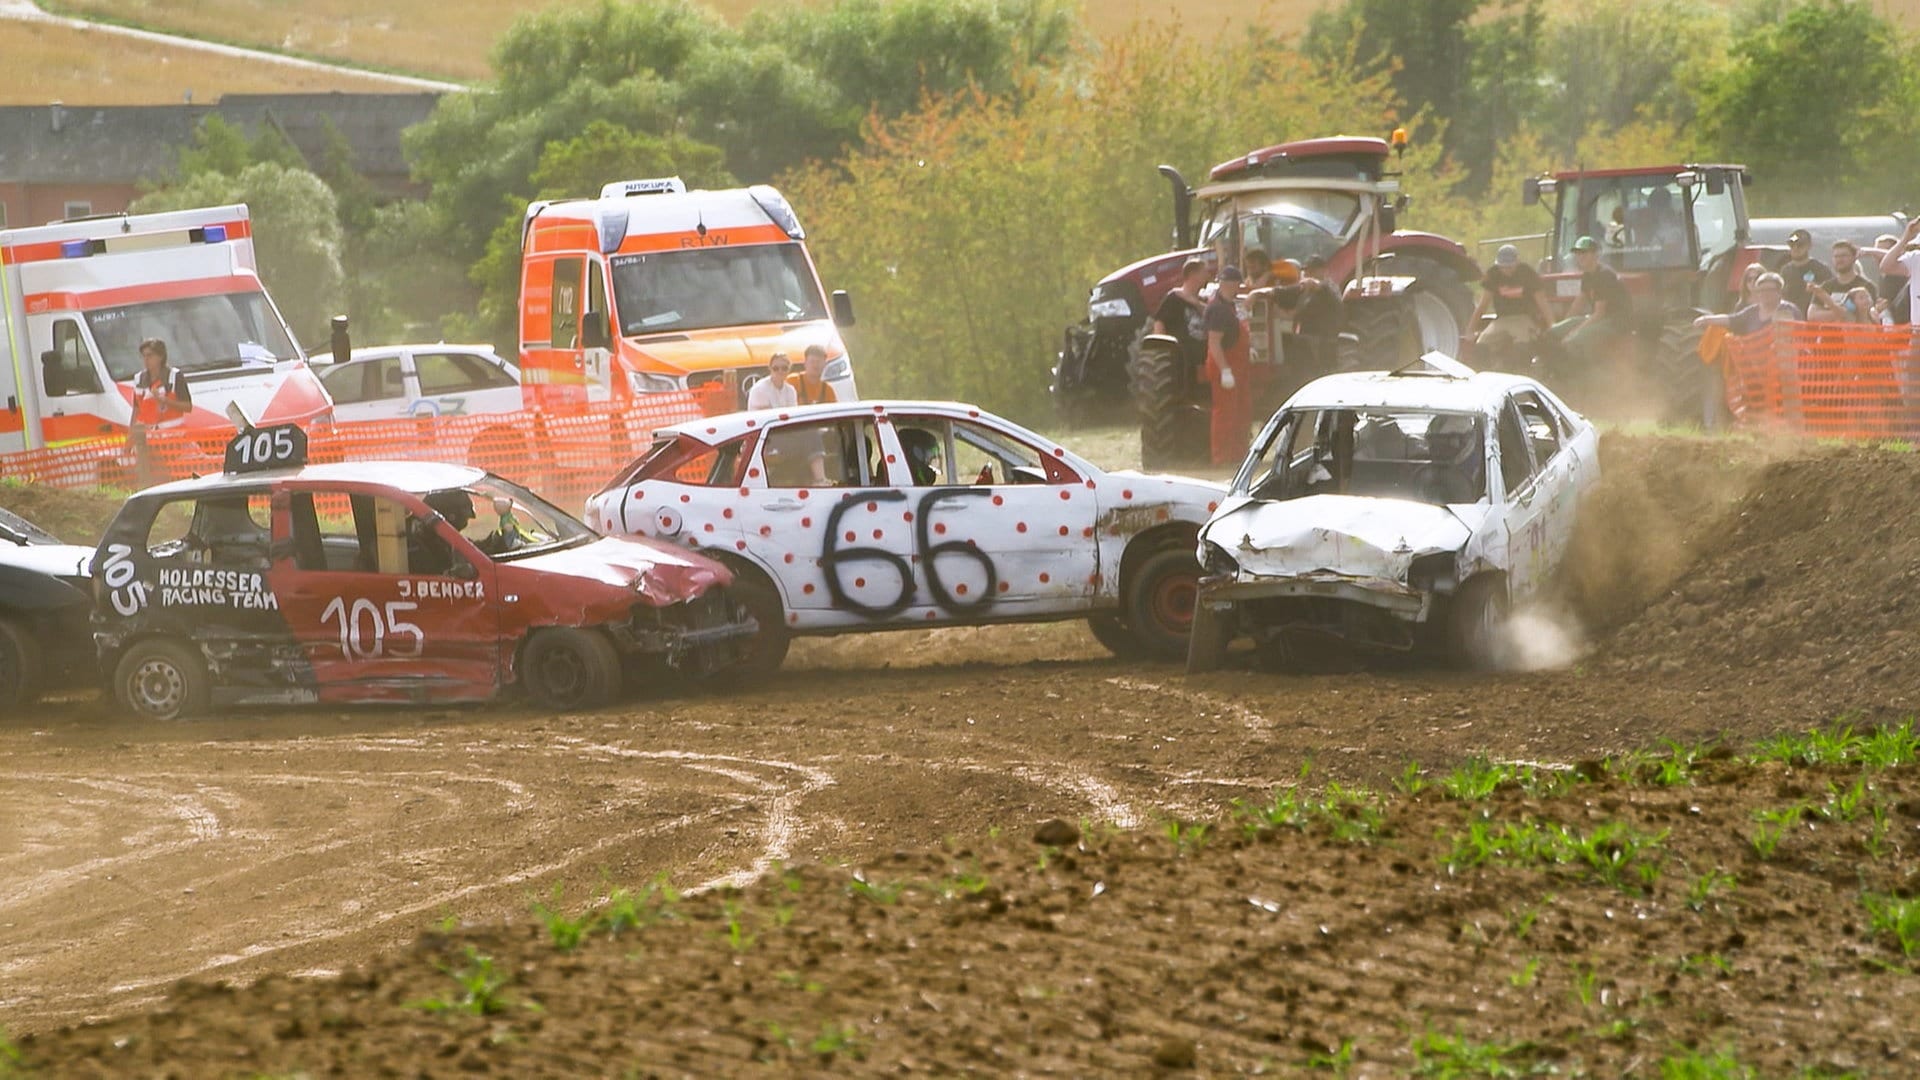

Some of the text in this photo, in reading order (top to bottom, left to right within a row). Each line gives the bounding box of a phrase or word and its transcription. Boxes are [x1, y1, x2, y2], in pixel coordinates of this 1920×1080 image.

[681, 234, 728, 248] RTW
[234, 428, 294, 464] 105
[822, 488, 997, 619] 66
[103, 544, 147, 616] 105
[160, 568, 263, 592] HOLDESSER
[162, 588, 278, 610] RACING TEAM
[320, 596, 424, 664] 105
